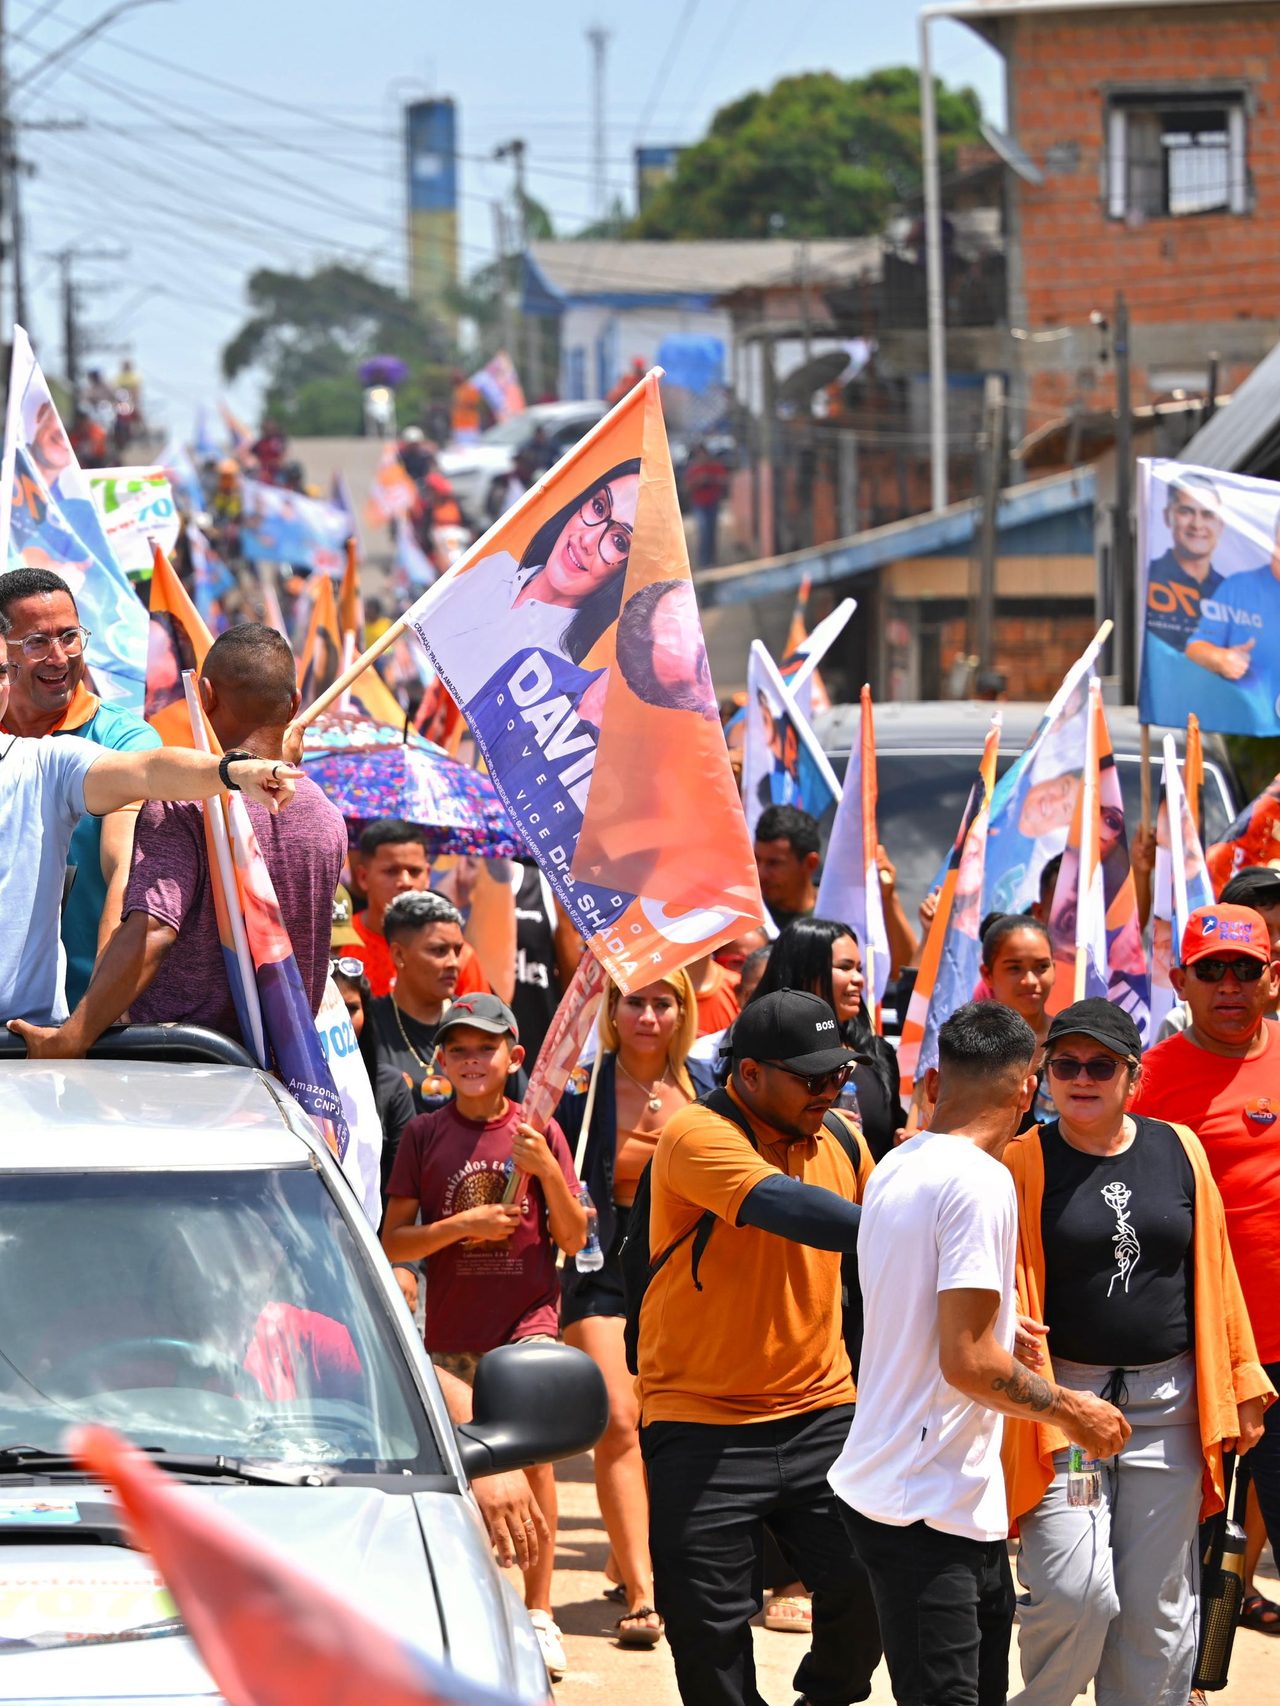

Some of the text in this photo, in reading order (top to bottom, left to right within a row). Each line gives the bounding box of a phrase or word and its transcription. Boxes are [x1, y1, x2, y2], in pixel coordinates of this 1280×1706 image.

[137, 498, 174, 522] 70
[516, 789, 639, 977] VICE Dra. SHÁDIA
[815, 1020, 835, 1032] BOSS
[314, 1098, 340, 1116] CNPJ
